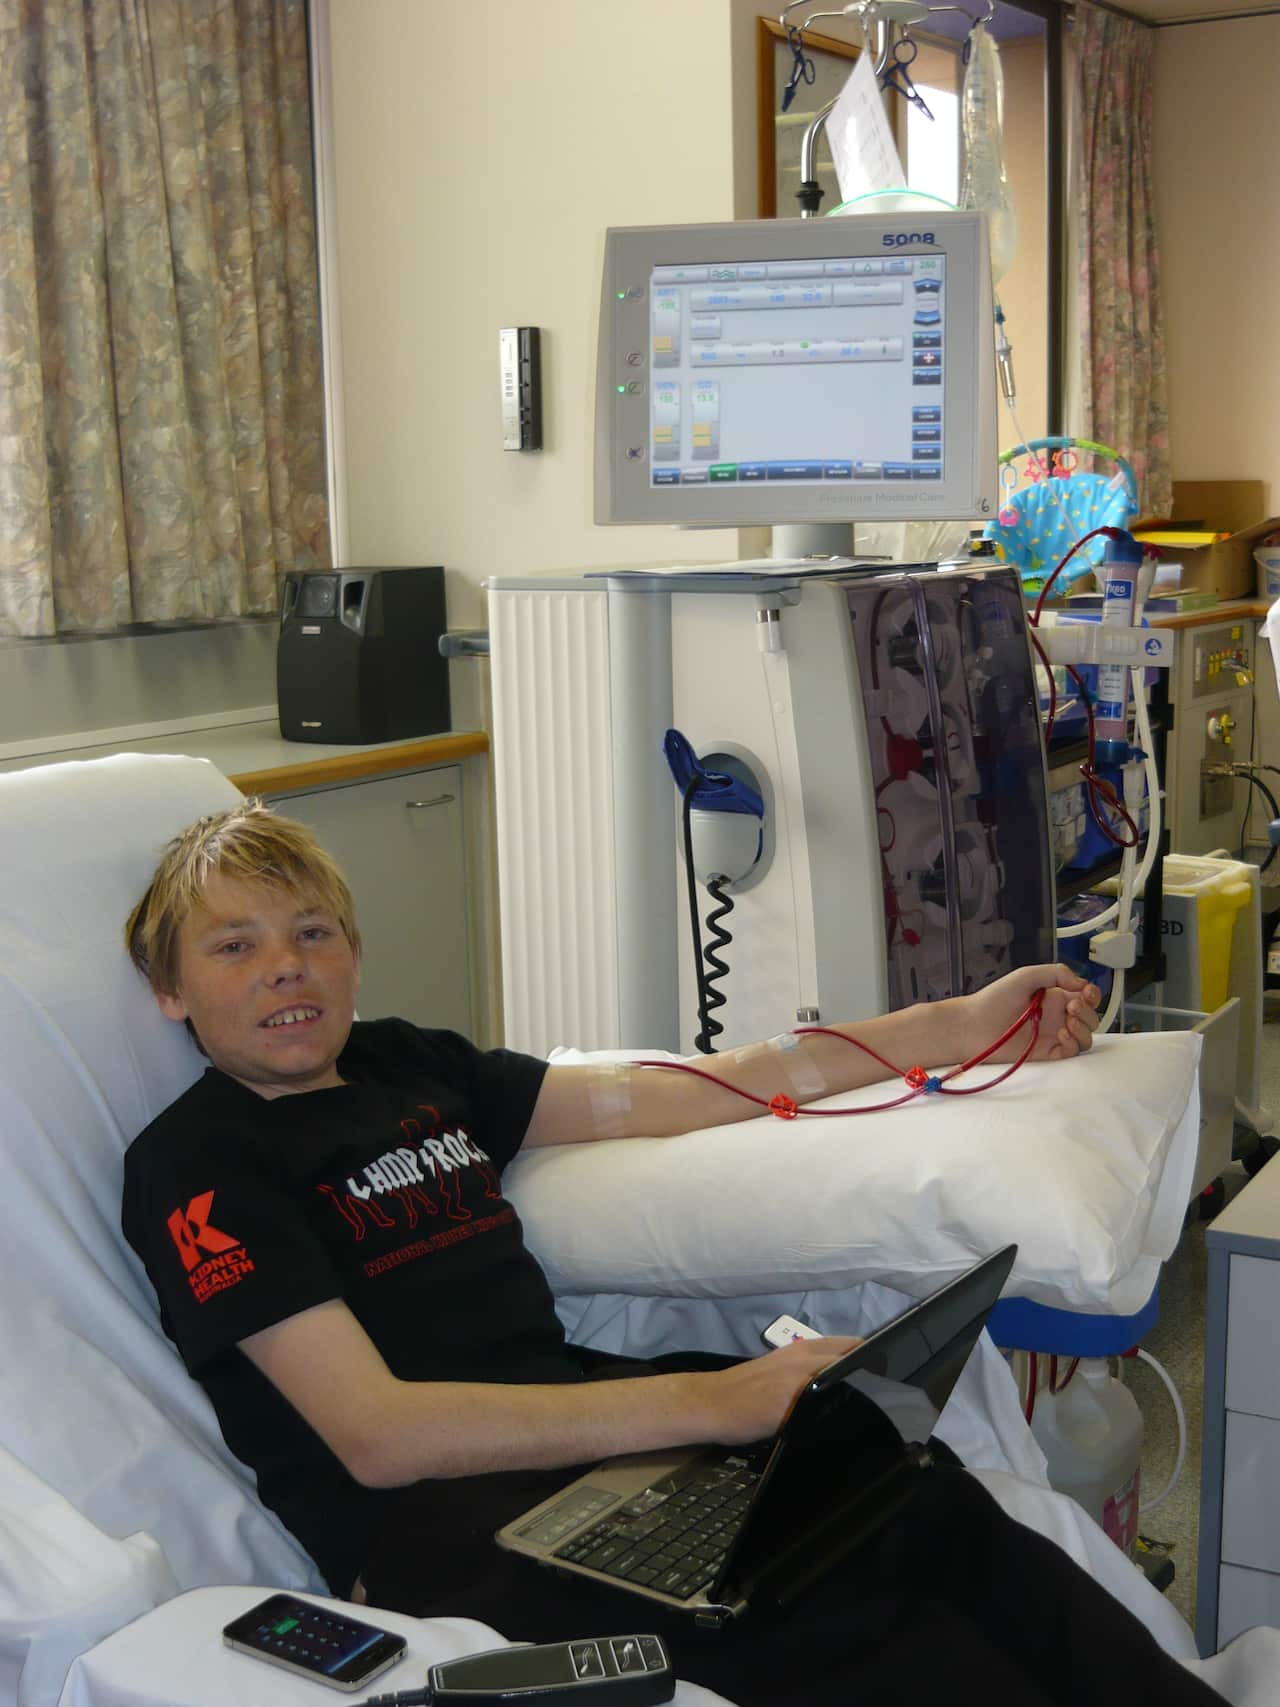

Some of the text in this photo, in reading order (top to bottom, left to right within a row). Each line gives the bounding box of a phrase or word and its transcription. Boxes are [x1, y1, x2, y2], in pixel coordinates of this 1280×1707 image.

[882, 232, 935, 247] 5008
[188, 1247, 247, 1288] KIDNEY
[194, 1259, 256, 1300] HEALTH
